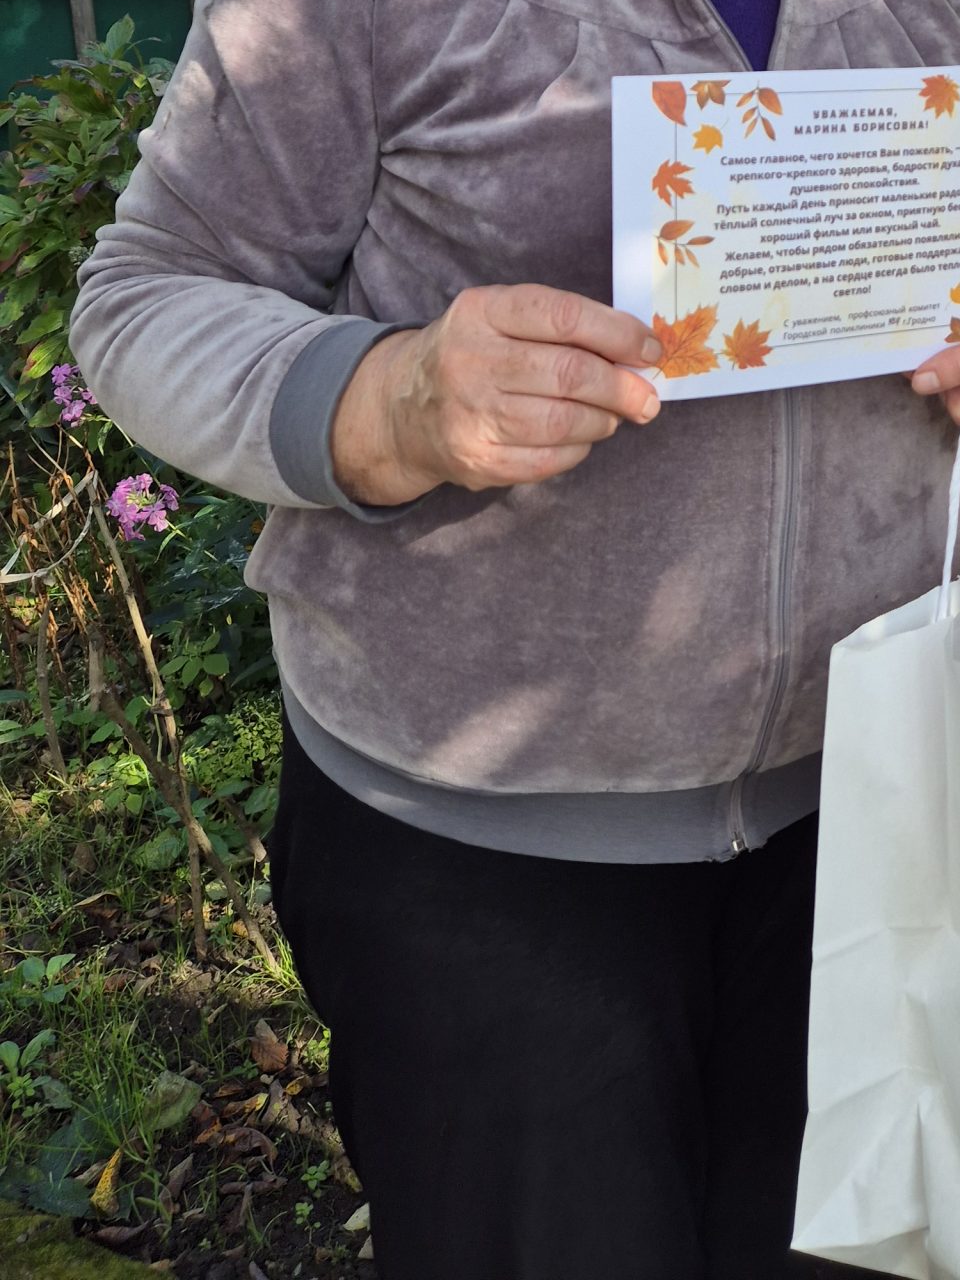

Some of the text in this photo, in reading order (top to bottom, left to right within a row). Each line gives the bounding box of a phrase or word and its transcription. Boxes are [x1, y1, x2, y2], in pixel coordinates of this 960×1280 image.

[813, 108, 898, 119] УВАЖАЕМАЯ,
[794, 121, 929, 135] МАРИНА БОРИСОВНА!
[721, 156, 757, 165] Самое
[760, 153, 807, 164] главное,
[810, 152, 834, 161] чего
[837, 149, 877, 160] хочется
[880, 148, 900, 157] Вам
[903, 146, 953, 157] пожелать,
[730, 167, 836, 181] крепкого-крепкого
[839, 164, 890, 177] здоровья,
[892, 161, 939, 173] бодрости
[790, 178, 920, 195] душевного спокойствия.
[717, 204, 749, 215] Пусть
[752, 201, 798, 212] каждый
[800, 198, 826, 210] день
[829, 195, 879, 207] приносит
[882, 191, 937, 203] маленькие
[714, 218, 757, 230] тёплый
[760, 213, 822, 227] солнечный
[824, 214, 843, 224] луч
[846, 212, 856, 220] за
[859, 209, 895, 220] окном,
[897, 204, 946, 217] приятную
[760, 219, 941, 243] хороший фильм или вкусный чай.
[725, 251, 773, 262] Желаем,
[776, 245, 810, 257] чтобы
[813, 243, 846, 255] рядом
[849, 236, 912, 251] обязательно
[720, 267, 766, 280] добрые,
[769, 260, 836, 274] отзывчивые
[839, 256, 870, 267] люди,
[872, 252, 913, 264] готовые
[720, 283, 761, 294] словом
[773, 277, 811, 290] делом,
[813, 277, 819, 285] а
[822, 275, 835, 284] на
[837, 271, 873, 284] сердце
[875, 267, 908, 279] всегда
[910, 264, 935, 275] было
[833, 285, 871, 298] светло!
